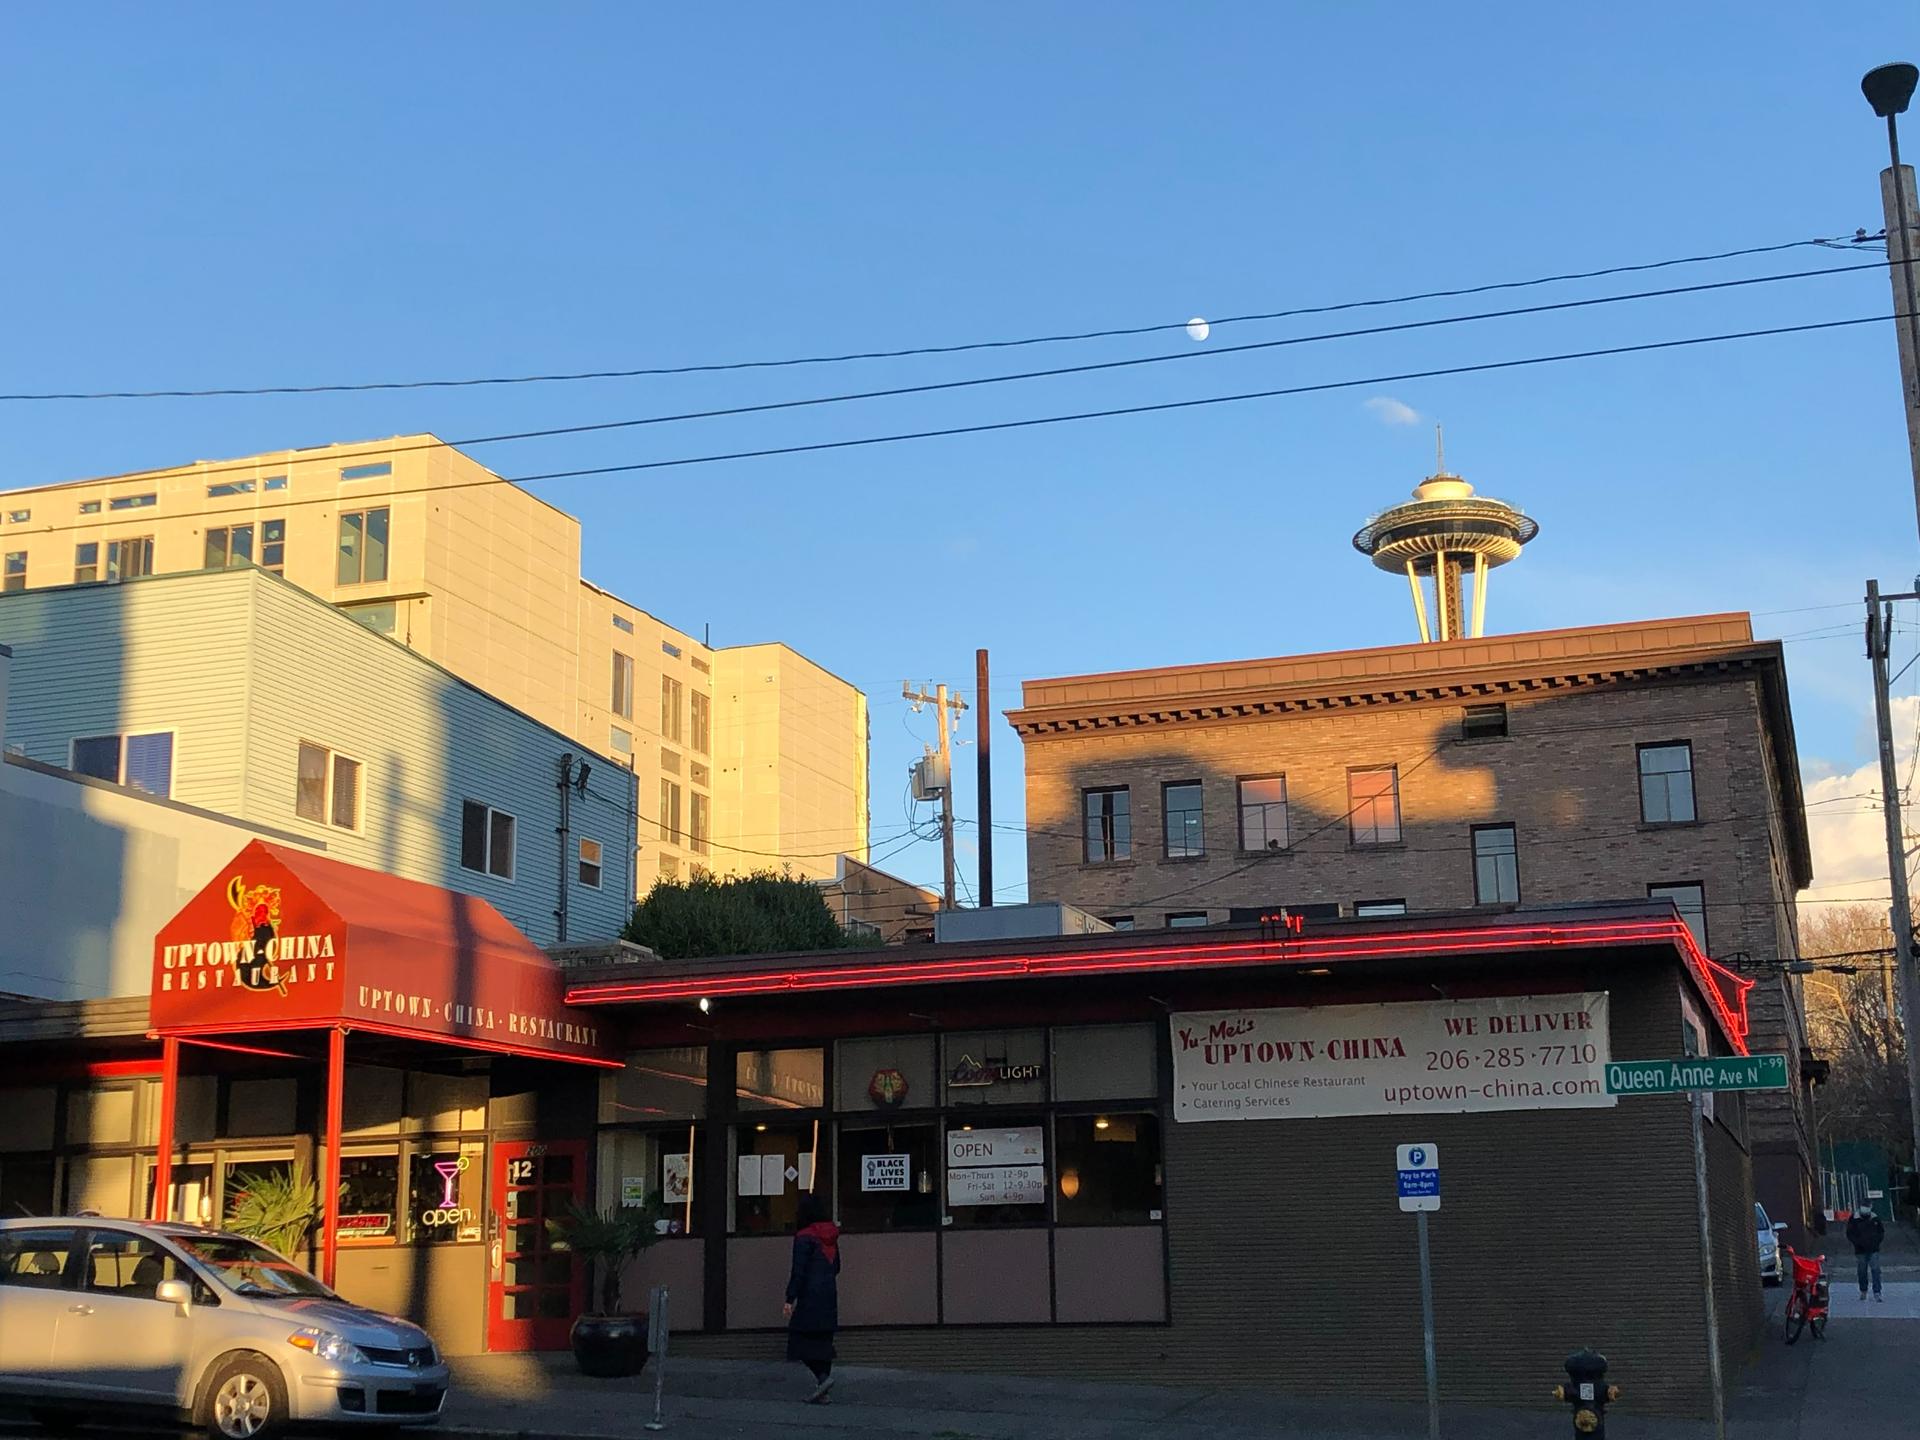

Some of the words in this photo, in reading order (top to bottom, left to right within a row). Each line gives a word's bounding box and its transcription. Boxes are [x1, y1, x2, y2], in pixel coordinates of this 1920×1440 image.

[162, 962, 335, 991] RESTAURANT
[359, 985, 432, 1018] UPTOWN
[444, 1002, 494, 1029] CHINA
[509, 1012, 598, 1047] RESTAURANT
[1444, 1017, 1478, 1037] WE
[1488, 1011, 1593, 1035] DELIVER
[1000, 1065, 1041, 1080] LIGHT
[1610, 1066, 1664, 1090] Queen
[1670, 1063, 1714, 1087] Anne
[1719, 1070, 1743, 1085] Ave
[1747, 1067, 1758, 1083] N
[1192, 1081, 1217, 1091] Your
[1222, 1079, 1250, 1090] Local
[1254, 1077, 1299, 1089] Chinese
[1303, 1075, 1366, 1087] Restaurant
[1384, 1078, 1600, 1106] uptown-china.com
[1193, 1099, 1241, 1111] Catering
[1245, 1096, 1290, 1107] Services
[953, 1143, 993, 1158] OPEN
[1413, 1151, 1422, 1163] P
[877, 1160, 904, 1169] BLACK
[880, 1168, 904, 1177] LIVES
[868, 1177, 904, 1186] MATTER
[422, 1208, 472, 1227] open
